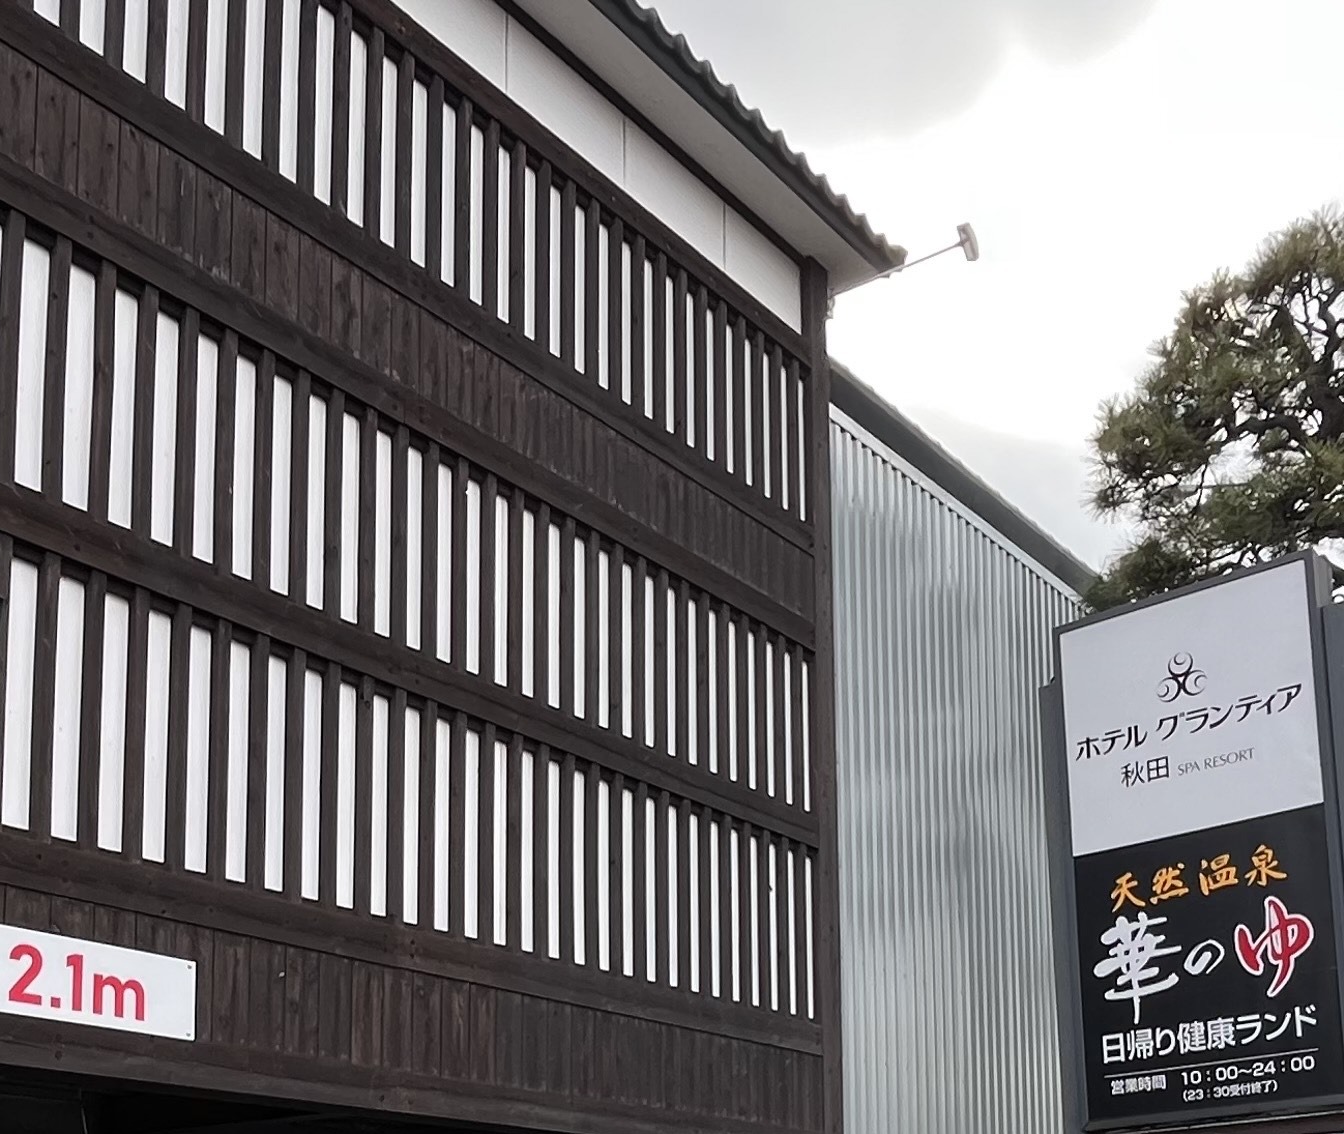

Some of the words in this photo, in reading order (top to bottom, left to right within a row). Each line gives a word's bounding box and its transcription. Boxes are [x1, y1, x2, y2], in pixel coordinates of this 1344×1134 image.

[1076, 725, 1148, 761] ホテル
[1156, 683, 1302, 741] グランティア
[1120, 756, 1170, 787] 秋田
[1177, 760, 1200, 776] SPA
[1204, 747, 1255, 769] RESORT
[1110, 844, 1288, 913] 天然温泉
[8, 943, 146, 1021] 2.1m
[1102, 1004, 1317, 1064] 日帰り健康ランド
[1110, 1074, 1166, 1096] 営業時間
